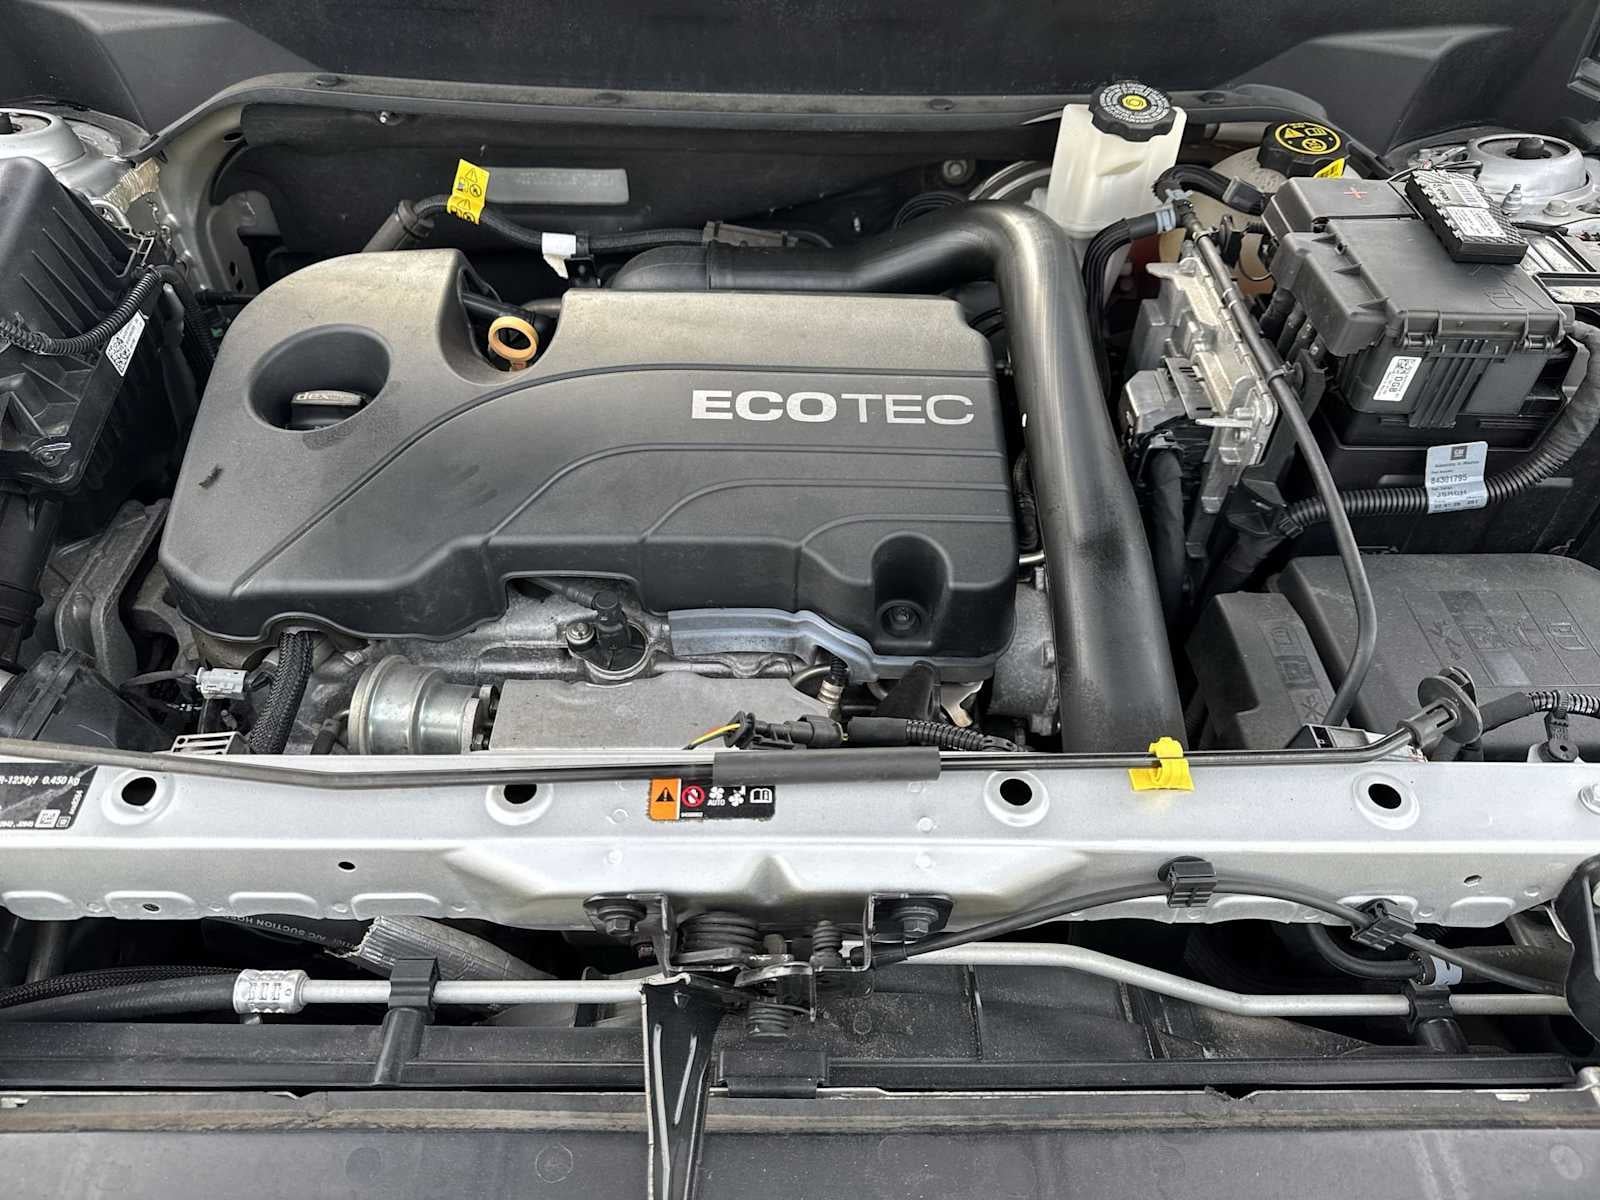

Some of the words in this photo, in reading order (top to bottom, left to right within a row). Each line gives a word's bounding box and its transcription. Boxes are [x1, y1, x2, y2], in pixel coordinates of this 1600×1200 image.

[691, 389, 975, 425] ECOTEC
[707, 798, 726, 807] AUTO
[255, 918, 306, 936] SUCTION
